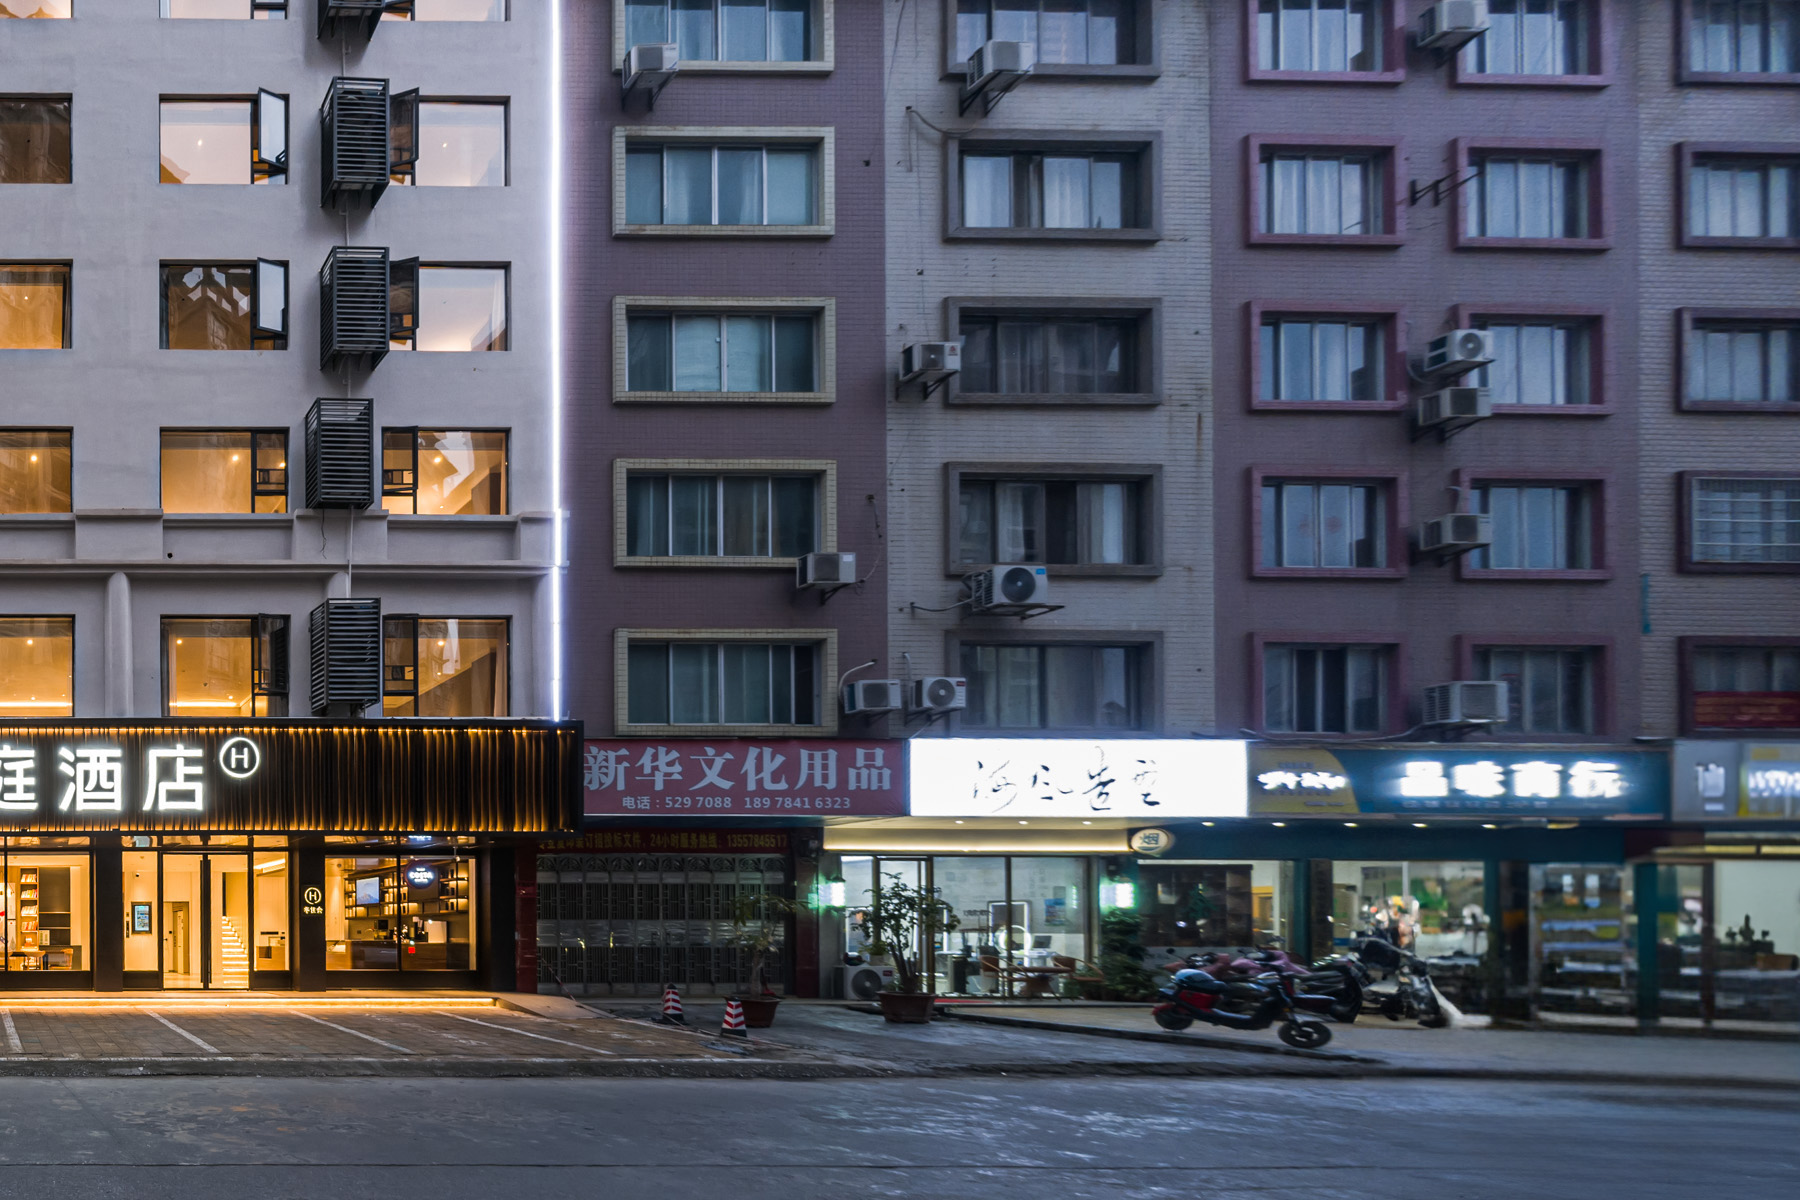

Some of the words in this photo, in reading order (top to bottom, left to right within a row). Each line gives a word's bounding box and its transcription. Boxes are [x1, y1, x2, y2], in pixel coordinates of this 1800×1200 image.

[583, 746, 892, 792] 新华文化用品
